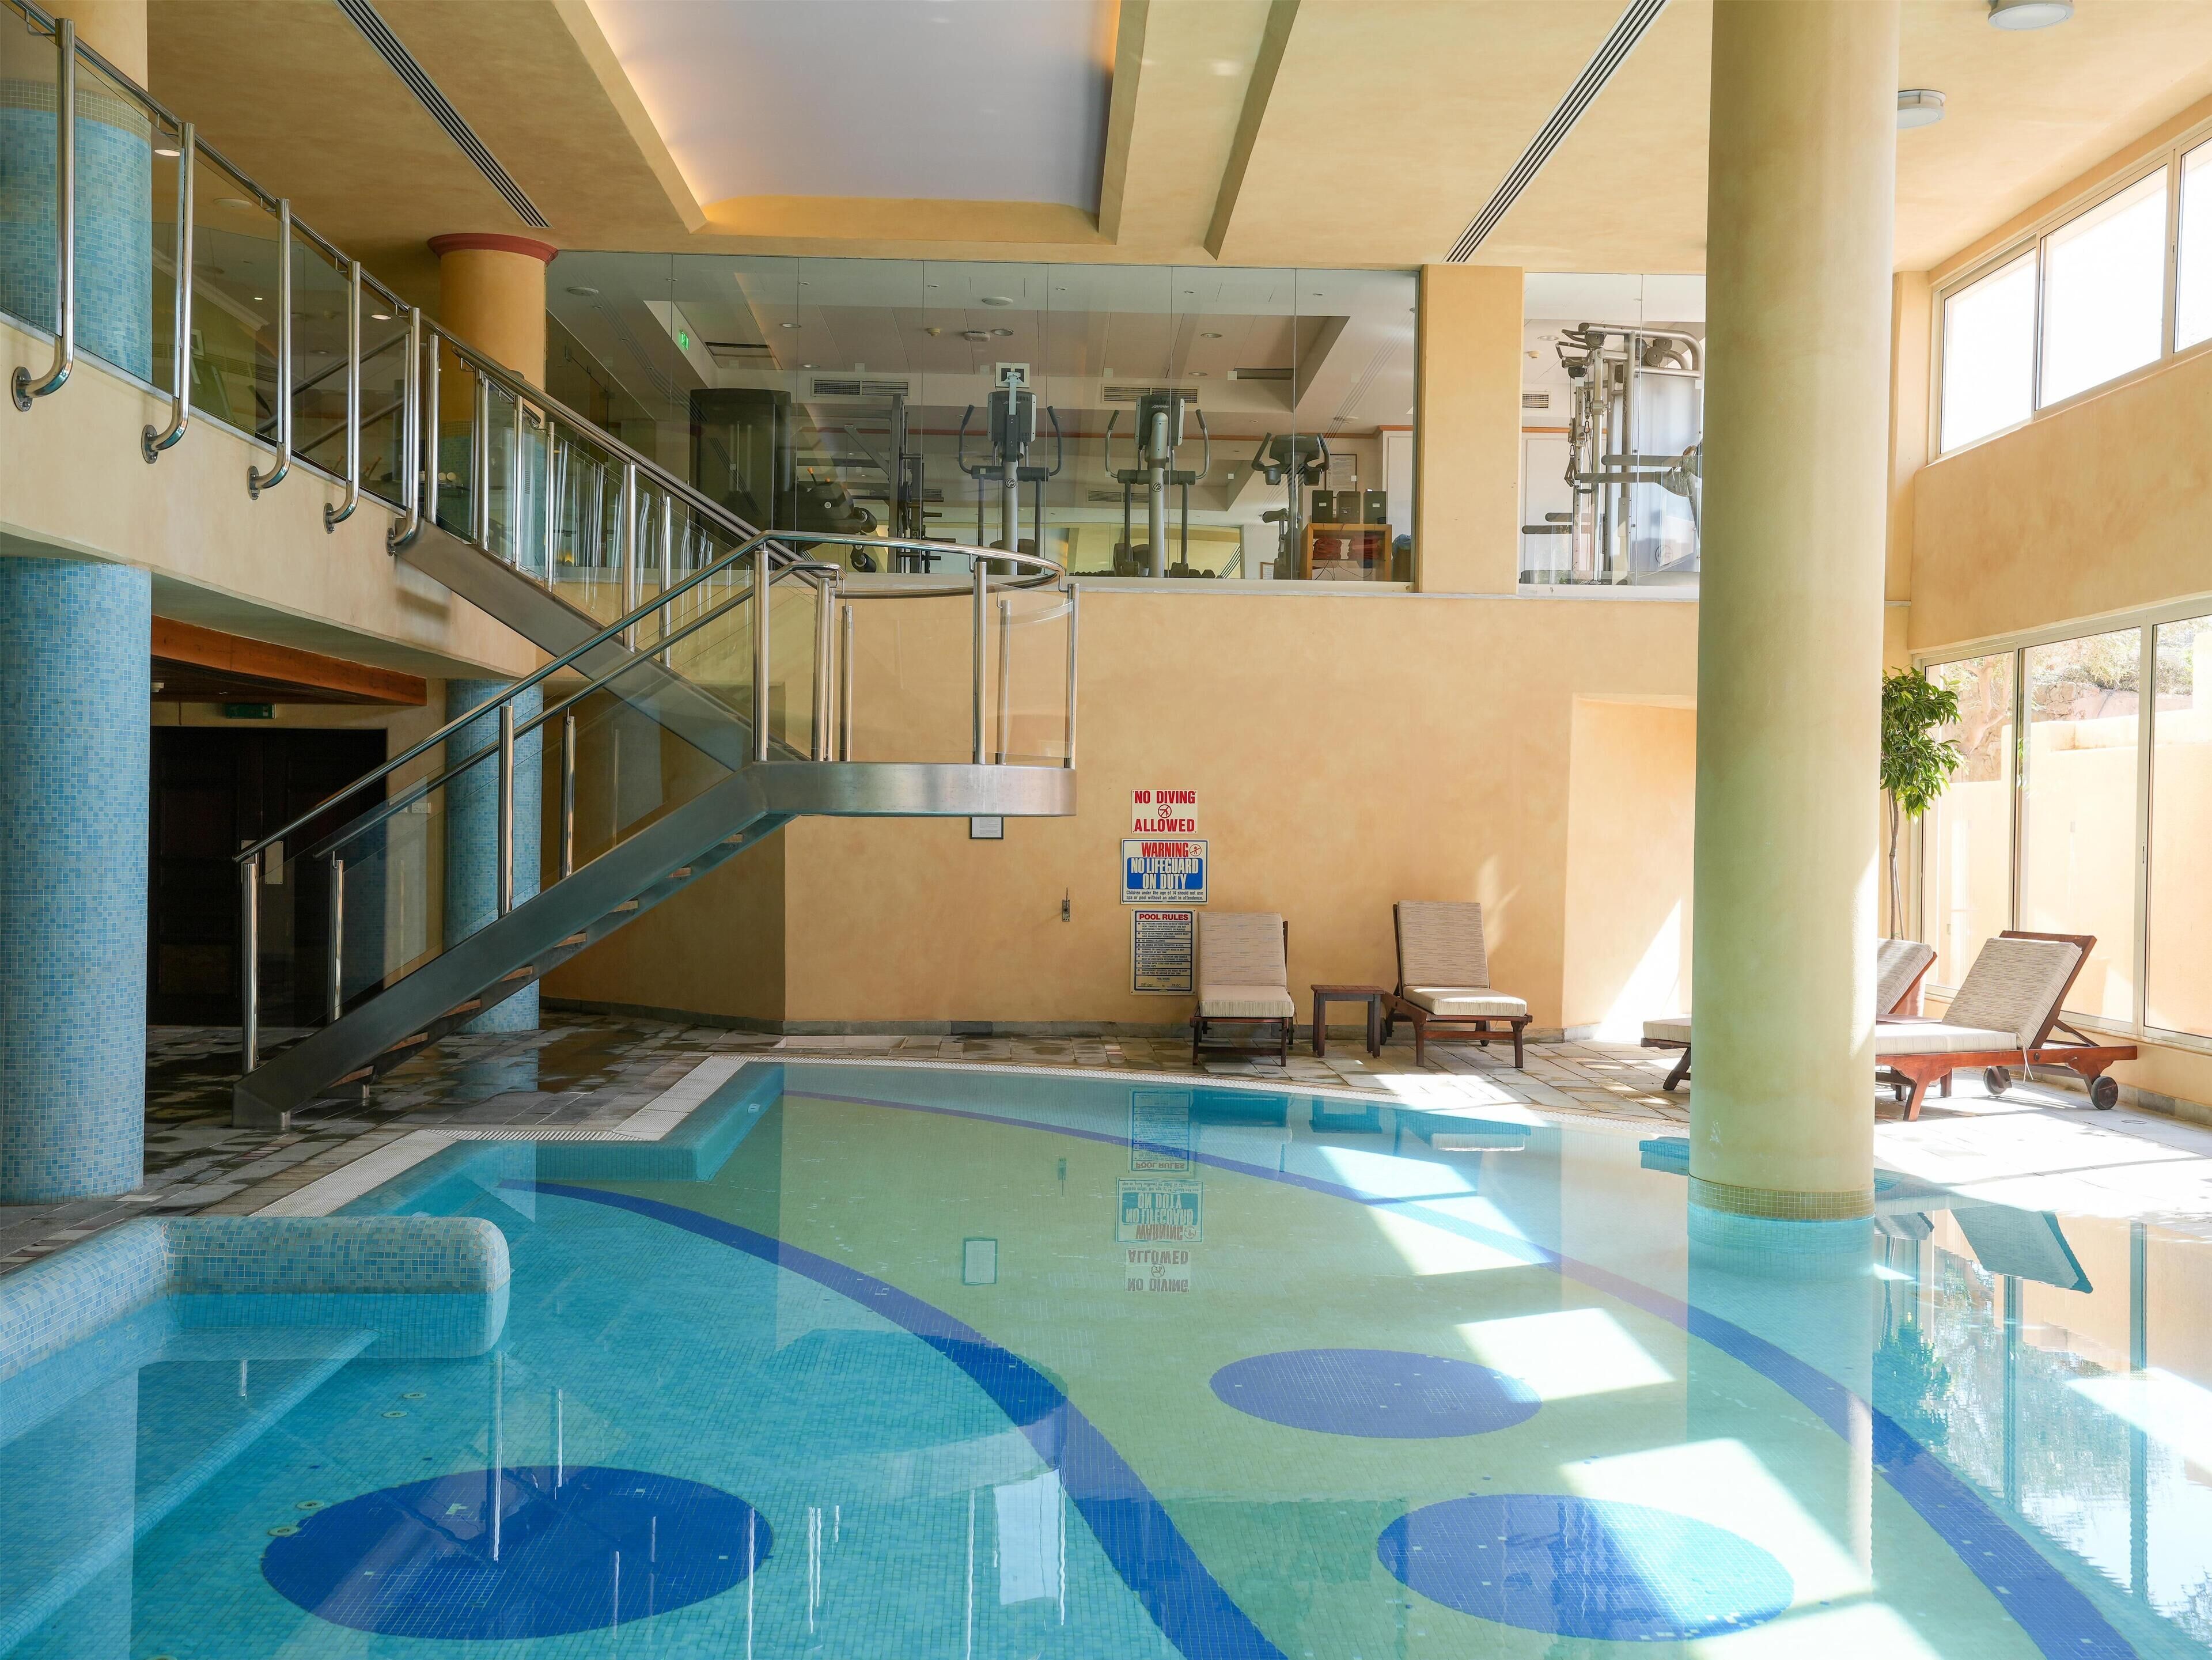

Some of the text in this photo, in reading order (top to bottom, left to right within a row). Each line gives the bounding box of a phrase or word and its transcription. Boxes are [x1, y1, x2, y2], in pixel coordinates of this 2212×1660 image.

[1134, 791, 1195, 804] NO DIVING
[1134, 819, 1195, 832] ALLOWED
[1142, 842, 1188, 858] WARNING
[1131, 858, 1198, 873] NO LIFEGUARD
[1142, 874, 1187, 889] ON DUTY
